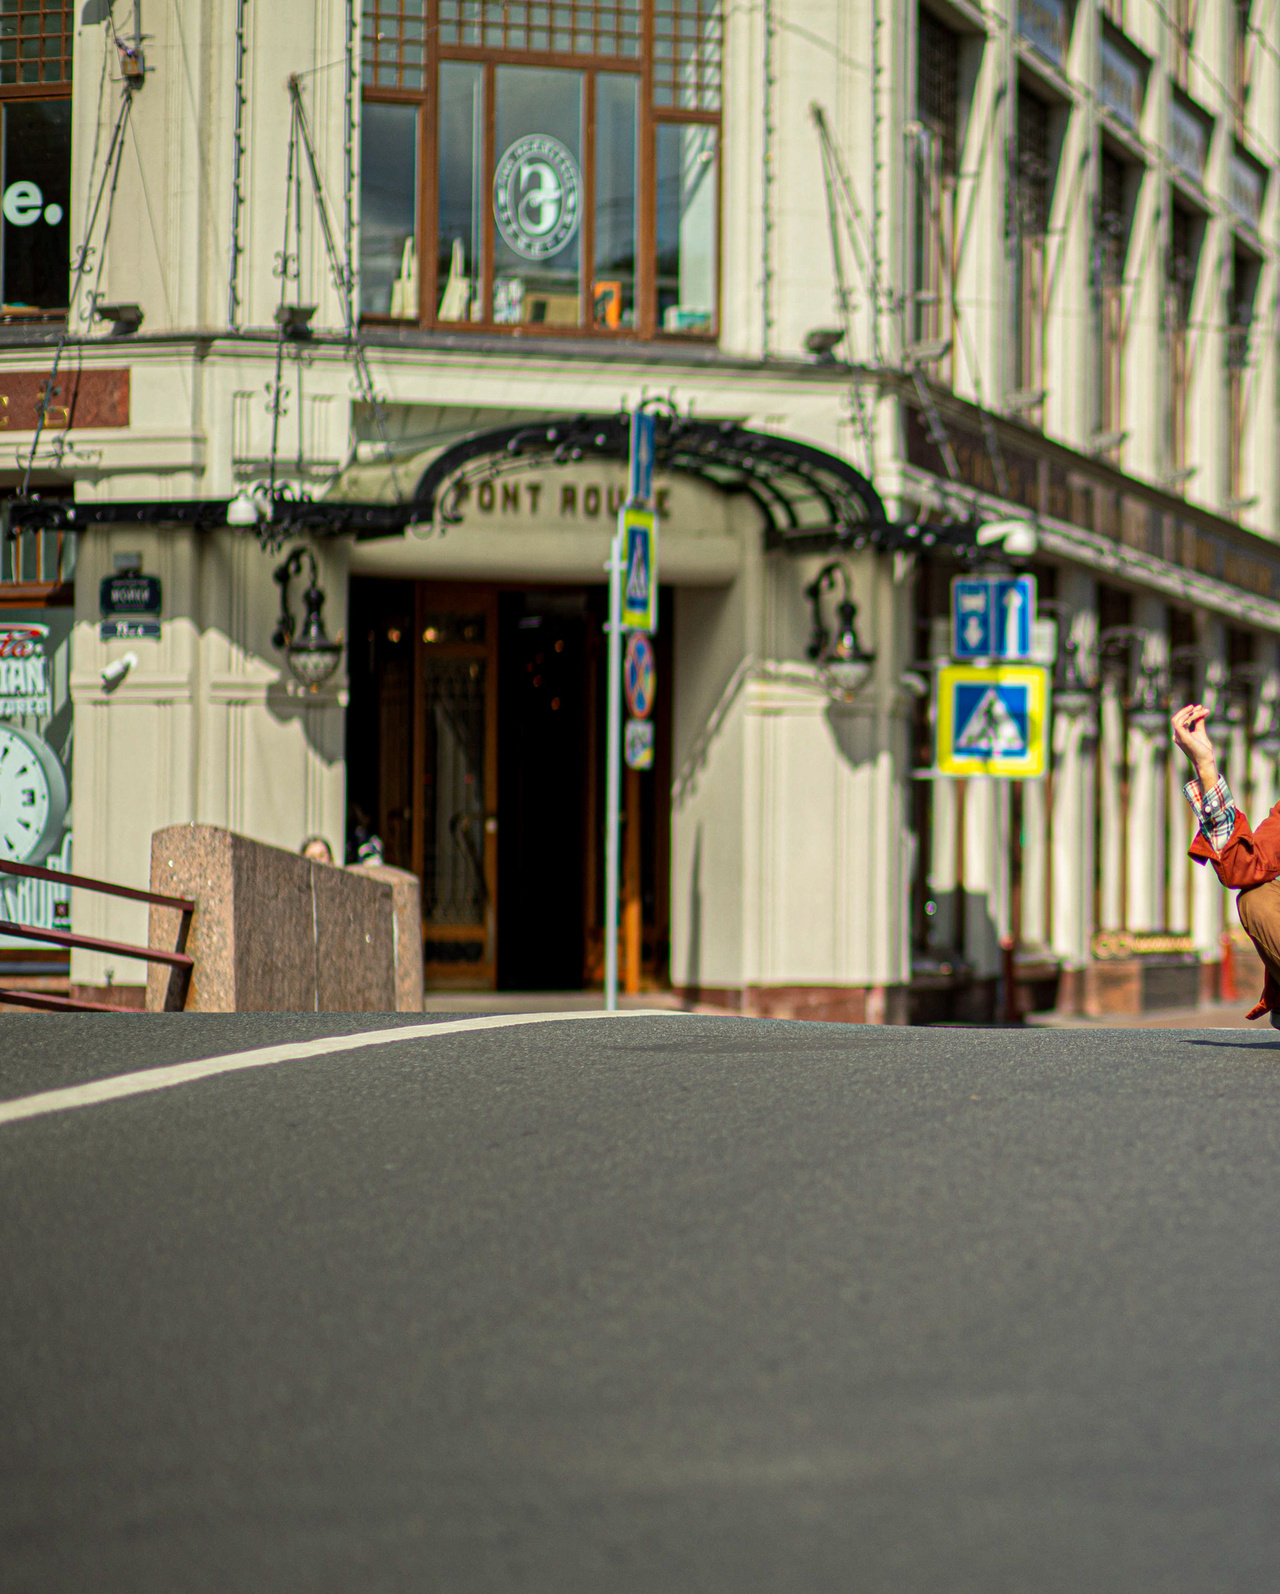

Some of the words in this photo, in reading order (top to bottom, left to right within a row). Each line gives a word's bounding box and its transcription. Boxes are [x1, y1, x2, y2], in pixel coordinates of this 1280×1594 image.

[2, 180, 63, 226] e.
[453, 480, 542, 514] PONT
[560, 482, 671, 519] ROUE
